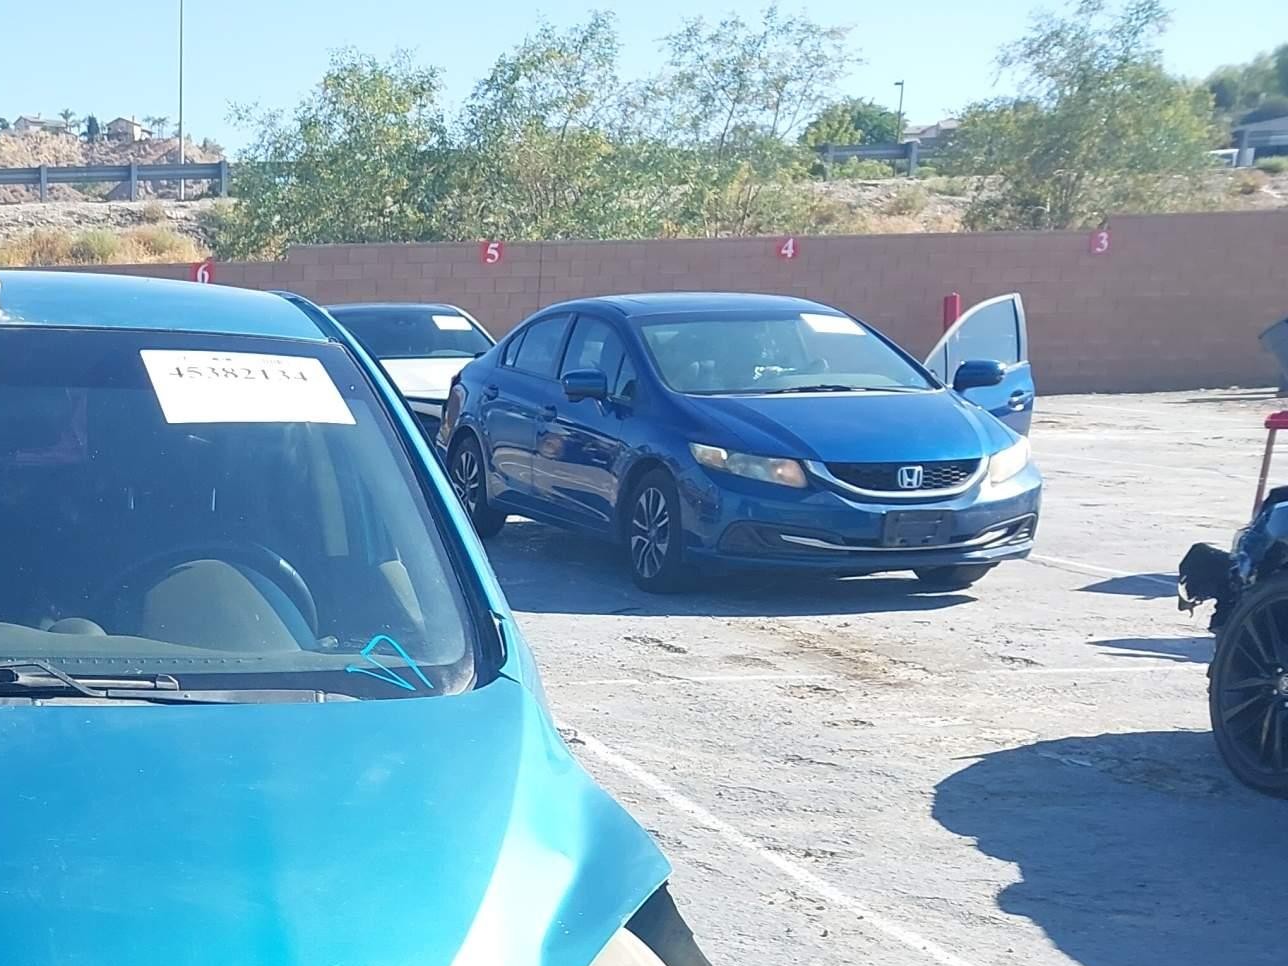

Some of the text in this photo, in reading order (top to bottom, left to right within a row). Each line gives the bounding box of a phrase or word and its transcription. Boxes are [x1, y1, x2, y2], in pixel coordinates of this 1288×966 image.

[781, 238, 794, 258] 4
[1096, 231, 1109, 252] 3
[486, 242, 500, 263] 5
[196, 263, 209, 283] 6
[168, 366, 309, 382] 45382134
